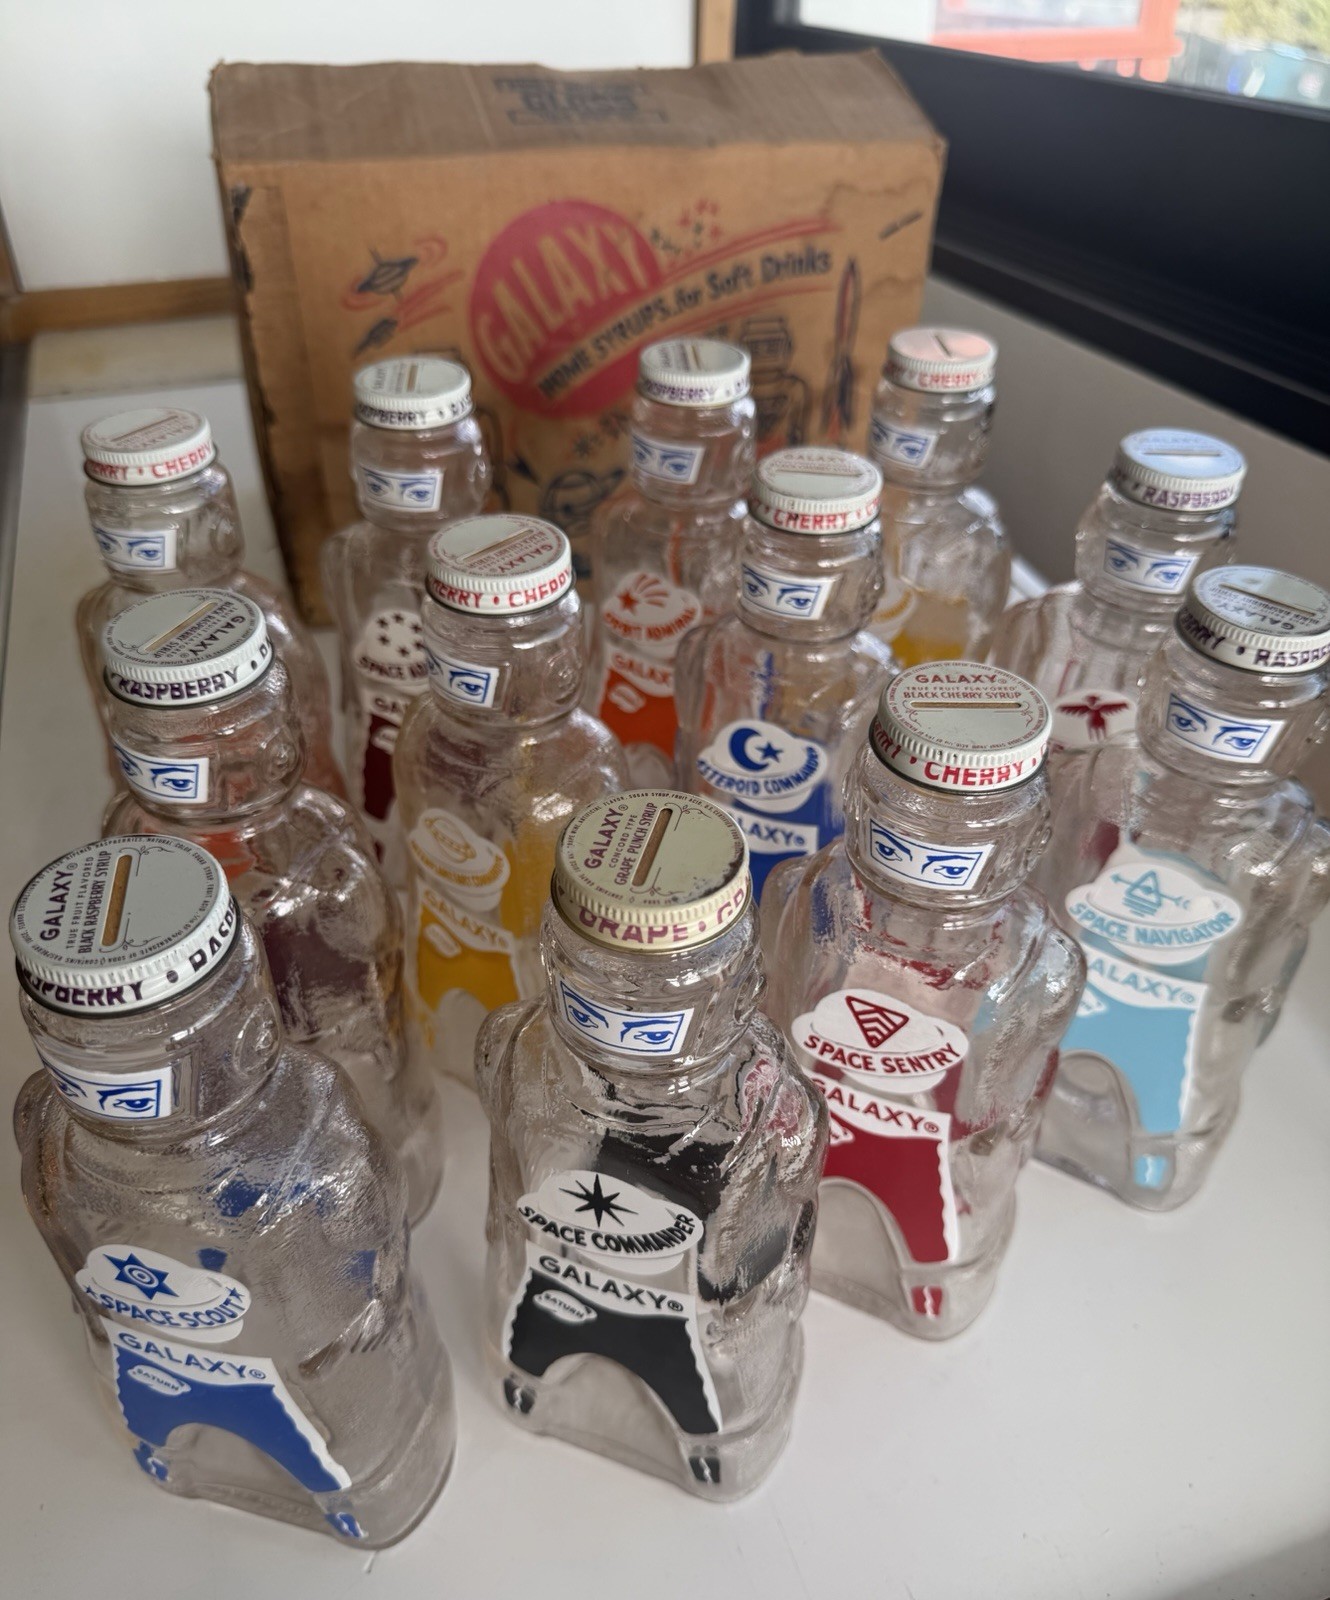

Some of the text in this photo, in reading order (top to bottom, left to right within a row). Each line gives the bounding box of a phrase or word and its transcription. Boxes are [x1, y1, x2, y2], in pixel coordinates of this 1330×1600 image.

[706, 264, 754, 300] Soft
[760, 248, 832, 284] Drinks
[478, 221, 650, 386] GALAXY
[773, 508, 849, 531] CHERRY
[495, 542, 554, 573] GALAXY
[185, 613, 246, 656] GALAXY
[111, 666, 239, 701] RASPBERRY
[614, 654, 671, 685] GALAX
[903, 691, 1023, 700] BLACK CHERRY SYRUP
[923, 760, 1024, 787] CHERRY
[607, 814, 638, 868] CONCORD TYPE
[612, 802, 658, 886] GRAPE PUNCH SYRUP
[64, 855, 94, 949] TRUE FRUIT FLAVORED
[77, 848, 111, 954] BLACK RASPBERRY SYRUP
[578, 904, 689, 945] GRAPE
[1068, 901, 1235, 945] SPACE NAVIGATOR
[803, 1034, 961, 1074] SPACE SENTRY
[518, 1205, 696, 1254] SPACE COMMANDER
[100, 1293, 246, 1329] SPACE SCOUT
[543, 1291, 585, 1319] SATURN
[136, 1367, 180, 1393] SATURN
